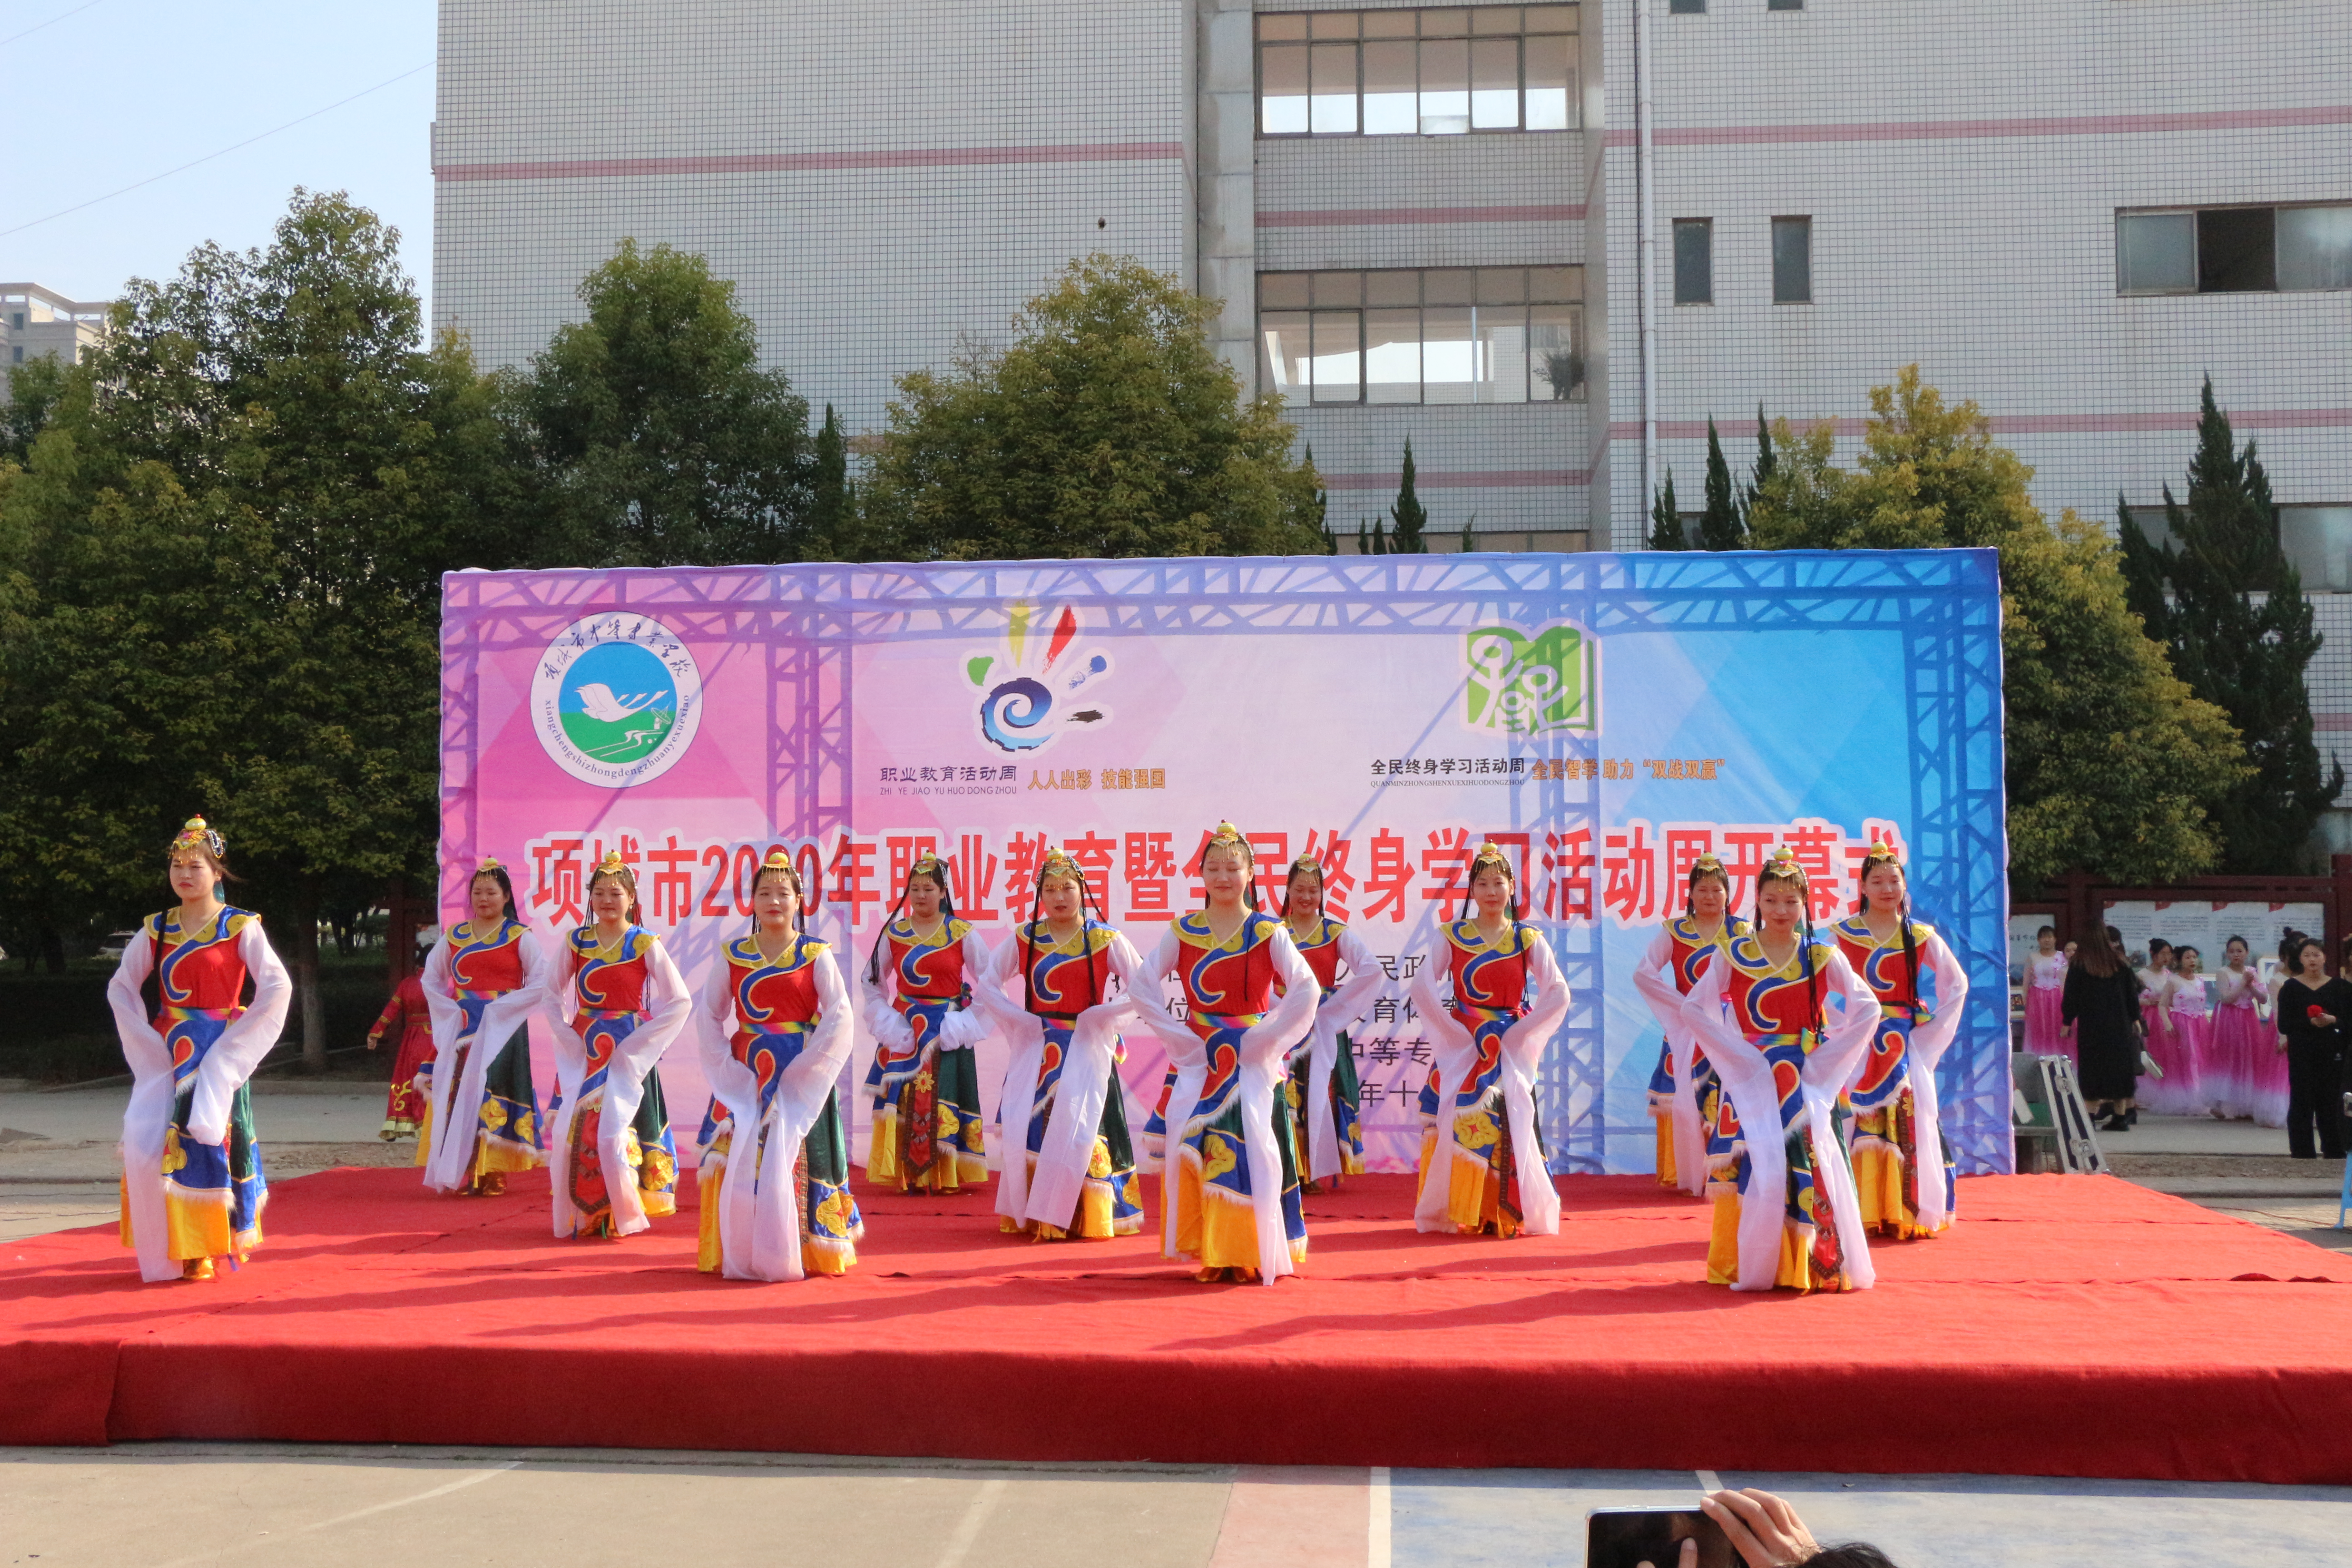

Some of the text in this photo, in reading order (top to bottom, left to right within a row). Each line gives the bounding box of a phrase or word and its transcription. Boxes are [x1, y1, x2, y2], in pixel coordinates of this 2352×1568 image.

[545, 695, 689, 779] xiangchengshizhongdengzhuanyexuexiao
[880, 765, 1017, 782] 职业教育活动周
[1371, 758, 1525, 775] 全民终身学习活动周
[1532, 759, 1598, 780] 全民智学
[1602, 759, 1634, 779] 助力
[1028, 768, 1165, 790] 人人出彩 技能强国
[1370, 779, 1525, 789] QUANMINZHONGSHENXUEXIHUODONGZHOU
[911, 787, 930, 795] JIAO
[967, 786, 993, 794] DONG
